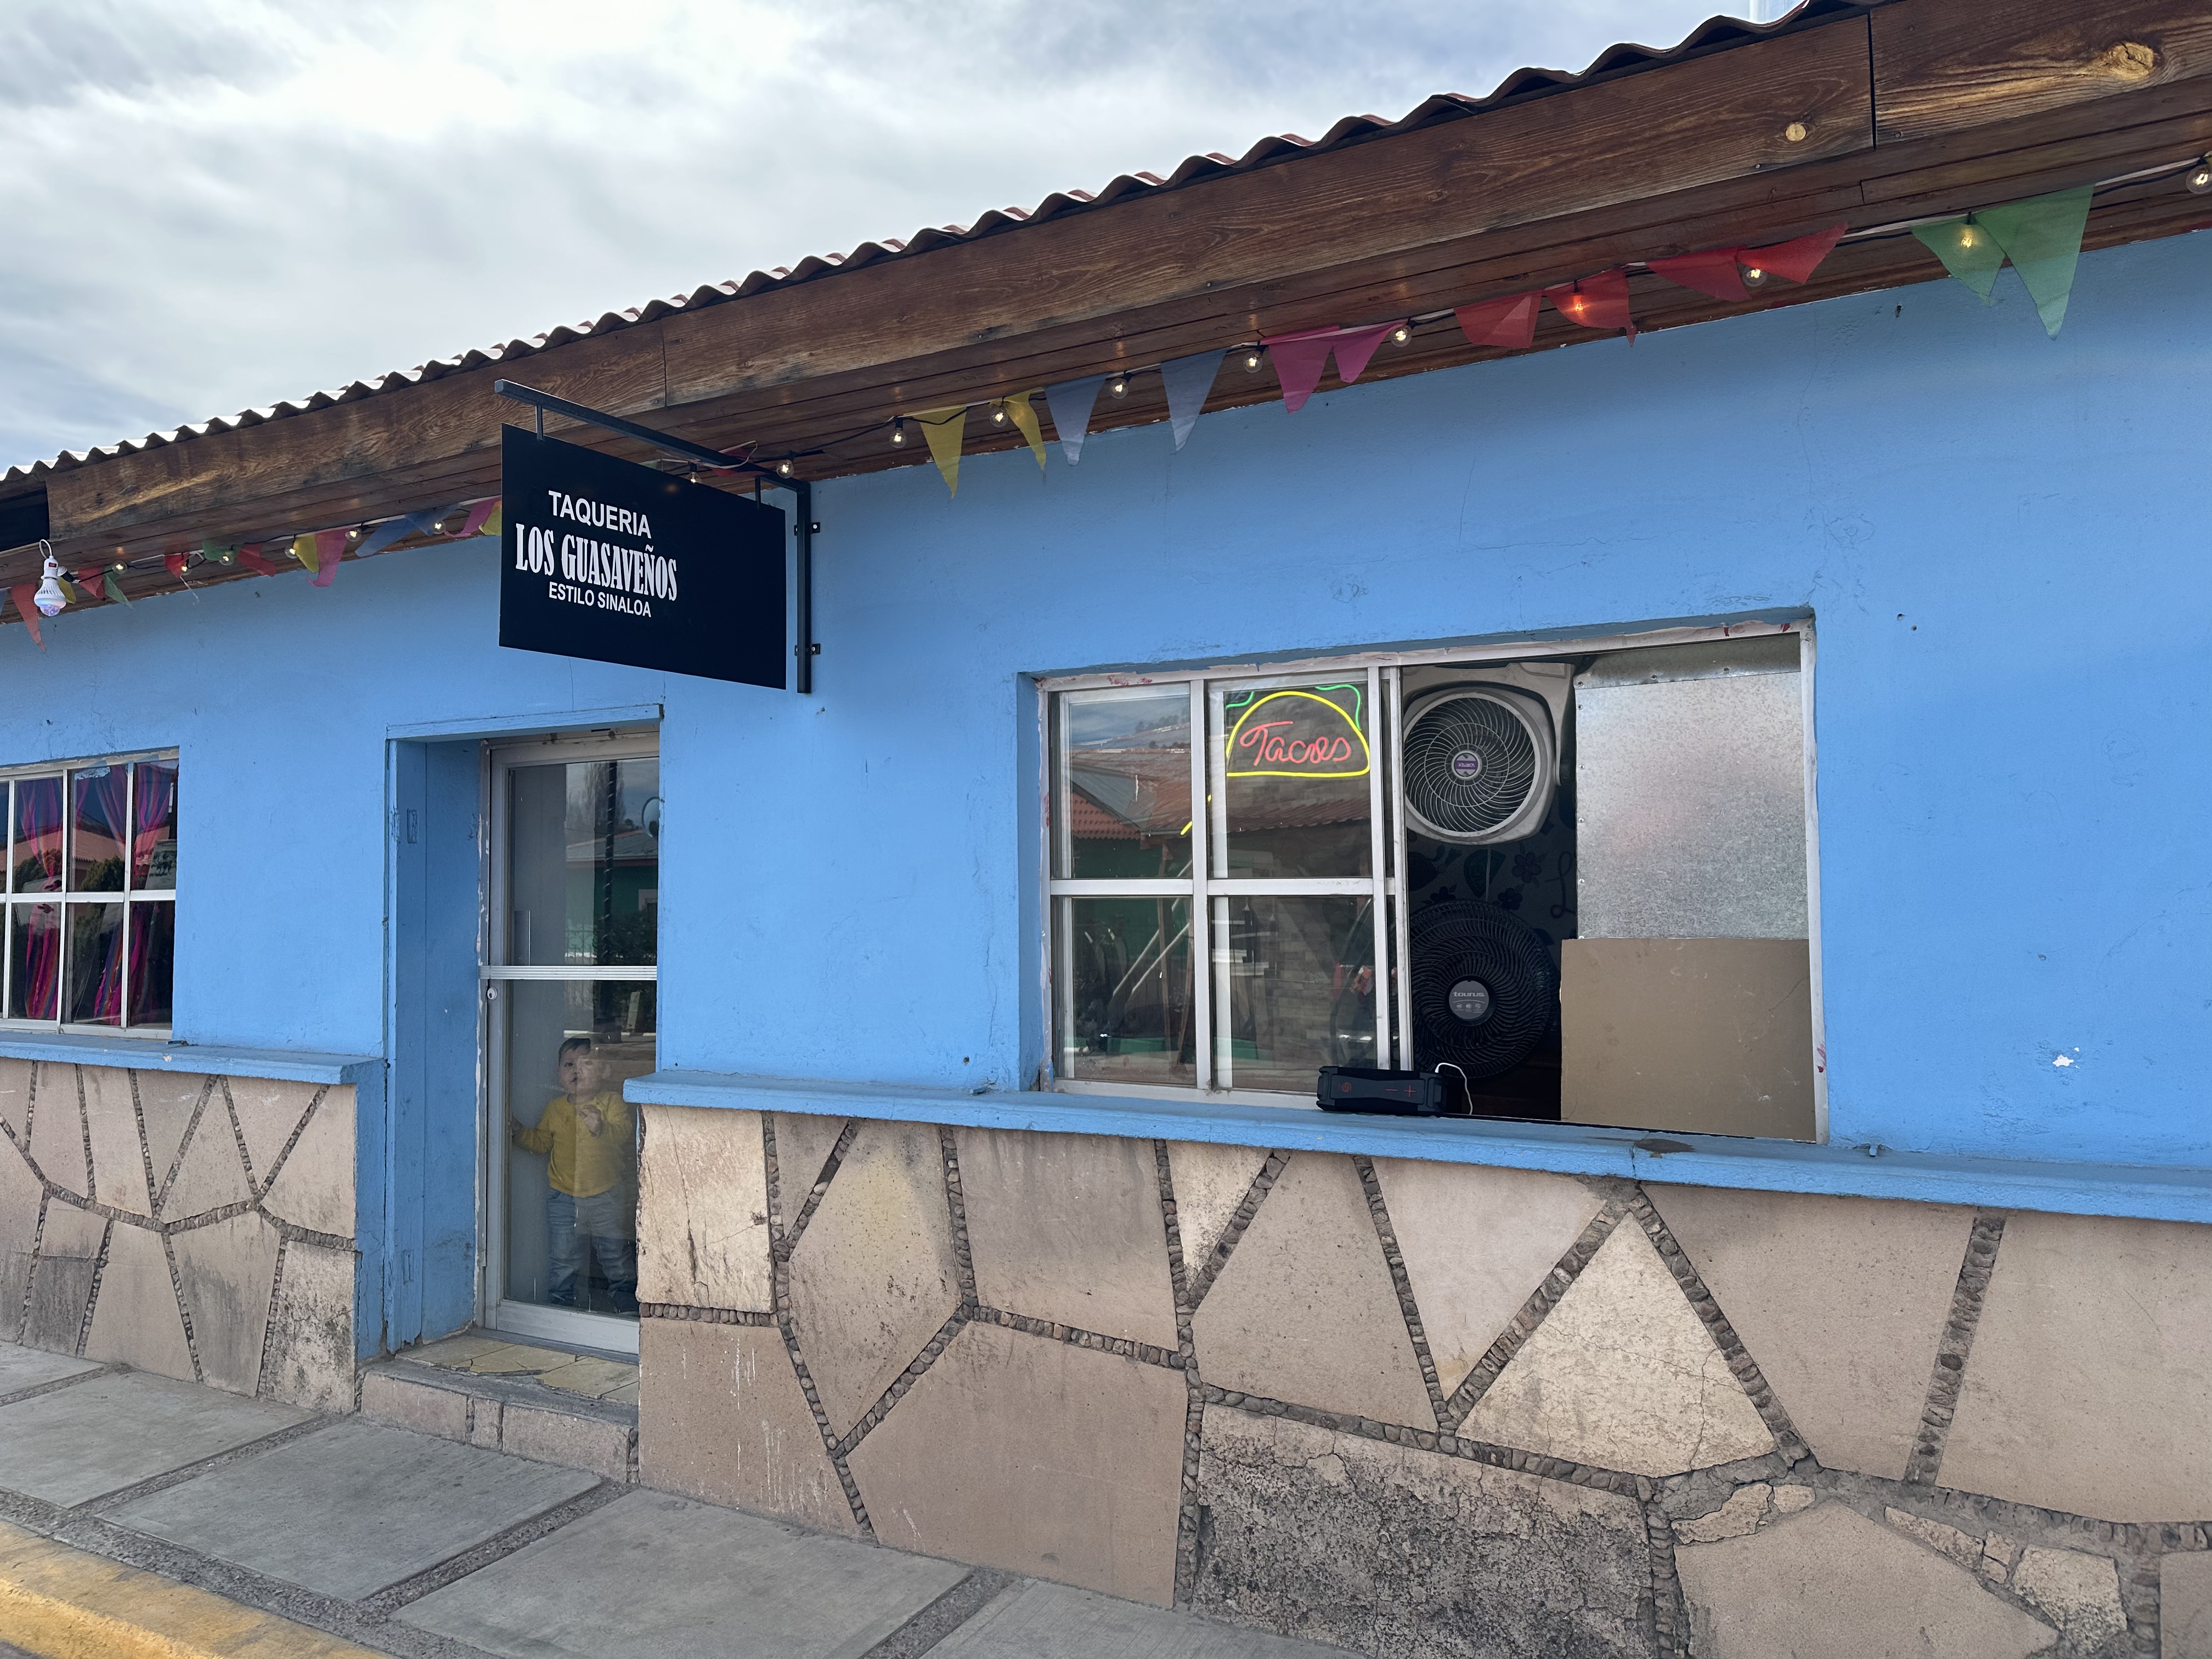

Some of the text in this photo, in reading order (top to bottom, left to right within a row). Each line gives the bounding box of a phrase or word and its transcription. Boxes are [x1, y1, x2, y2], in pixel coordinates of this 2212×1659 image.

[549, 490, 651, 539] TAQUERIA
[516, 523, 677, 601] LOS GUASAVEÑOS
[549, 582, 651, 617] ESTILO SINALOA
[1240, 721, 1351, 766] Tacos
